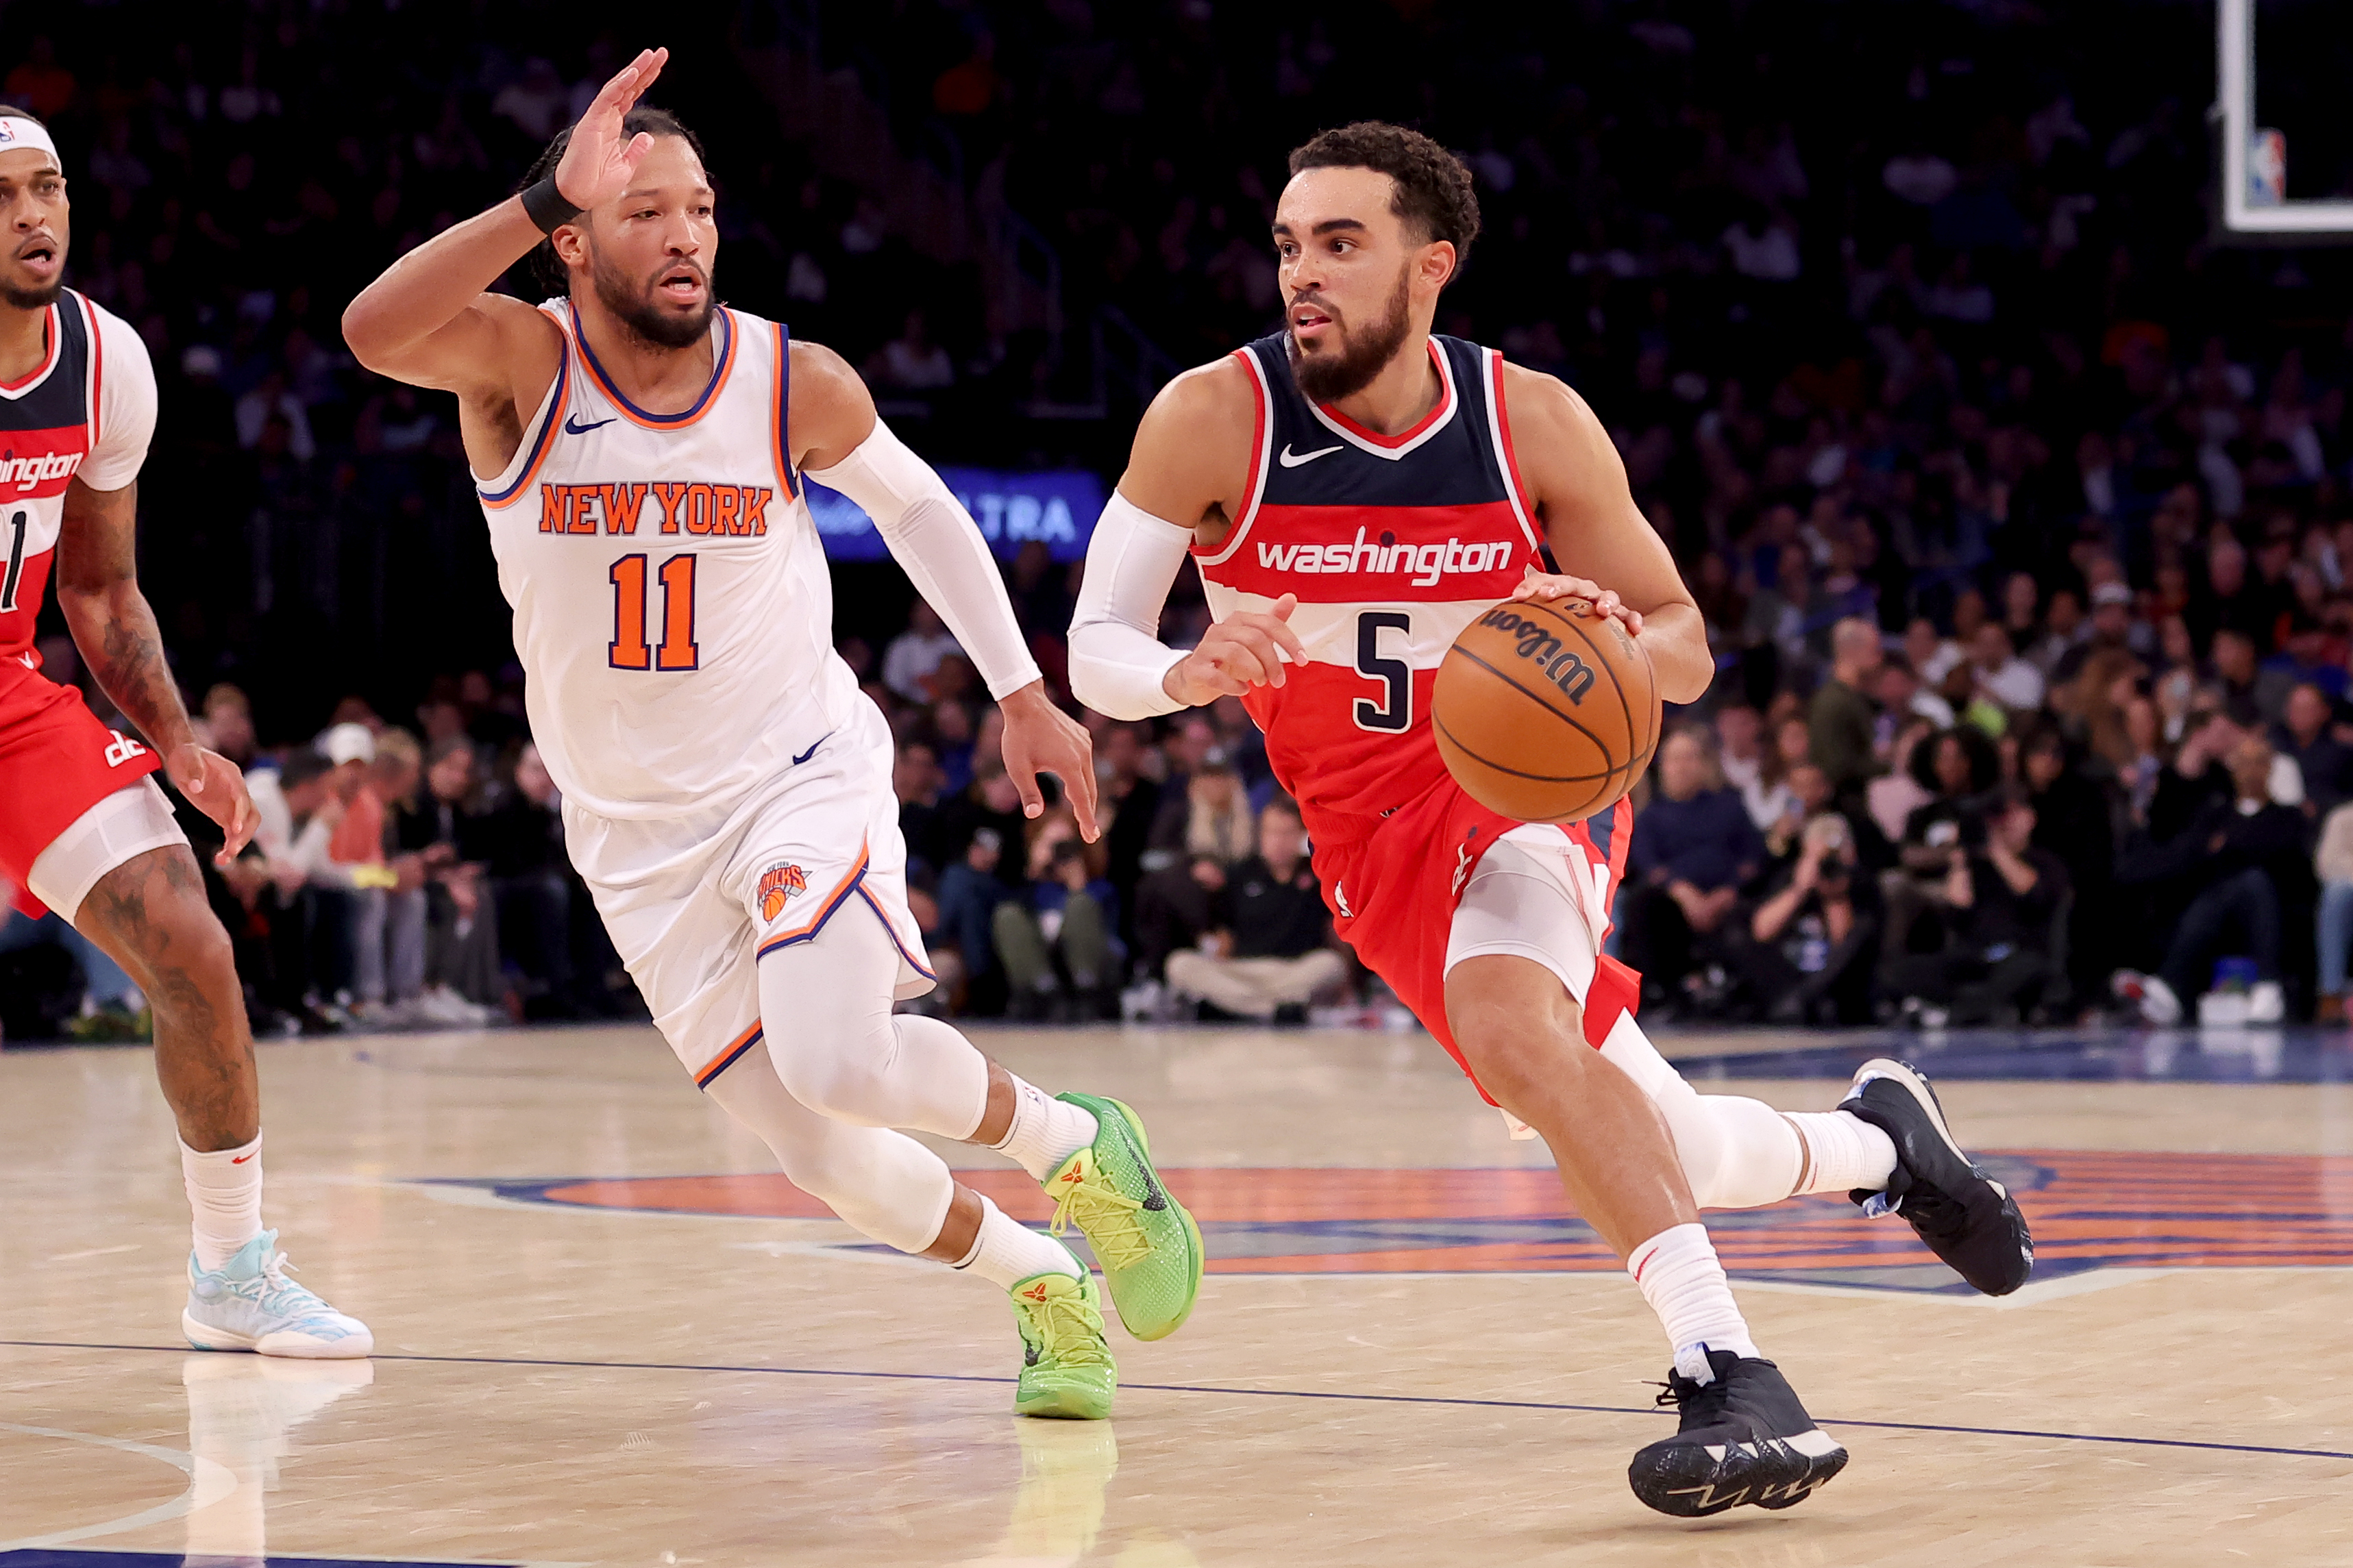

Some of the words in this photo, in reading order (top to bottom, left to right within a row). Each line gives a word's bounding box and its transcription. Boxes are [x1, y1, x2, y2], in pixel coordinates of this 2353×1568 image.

[540, 482, 648, 536] NEW
[652, 481, 772, 536] YORK
[959, 492, 1077, 543] TRA
[1257, 525, 1512, 586] washington
[608, 553, 698, 671] 11
[1353, 608, 1413, 734] 5
[1479, 609, 1596, 706] Wilson
[104, 730, 147, 768] dc
